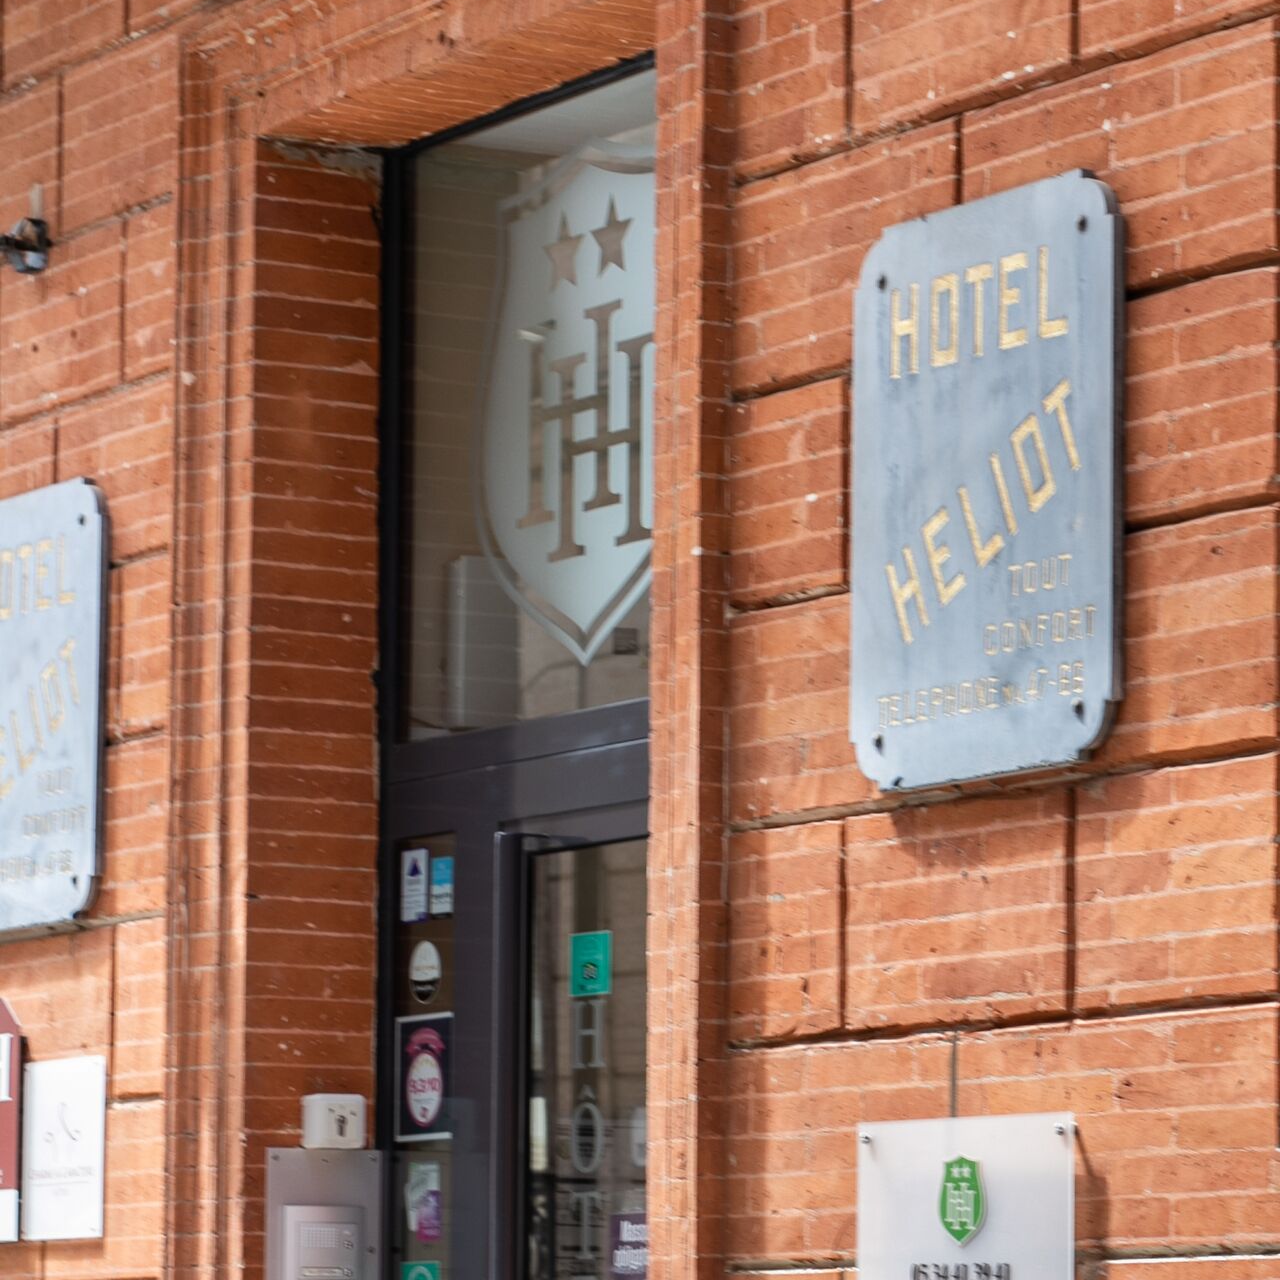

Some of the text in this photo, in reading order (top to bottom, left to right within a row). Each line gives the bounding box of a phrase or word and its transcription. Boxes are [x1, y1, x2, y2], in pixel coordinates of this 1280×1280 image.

[889, 245, 1069, 379] HOTEL
[885, 379, 1082, 645] HELIOT
[1008, 554, 1072, 596] TOUT
[984, 605, 1096, 656] CONFORT
[877, 676, 999, 728] TELEPHONE
